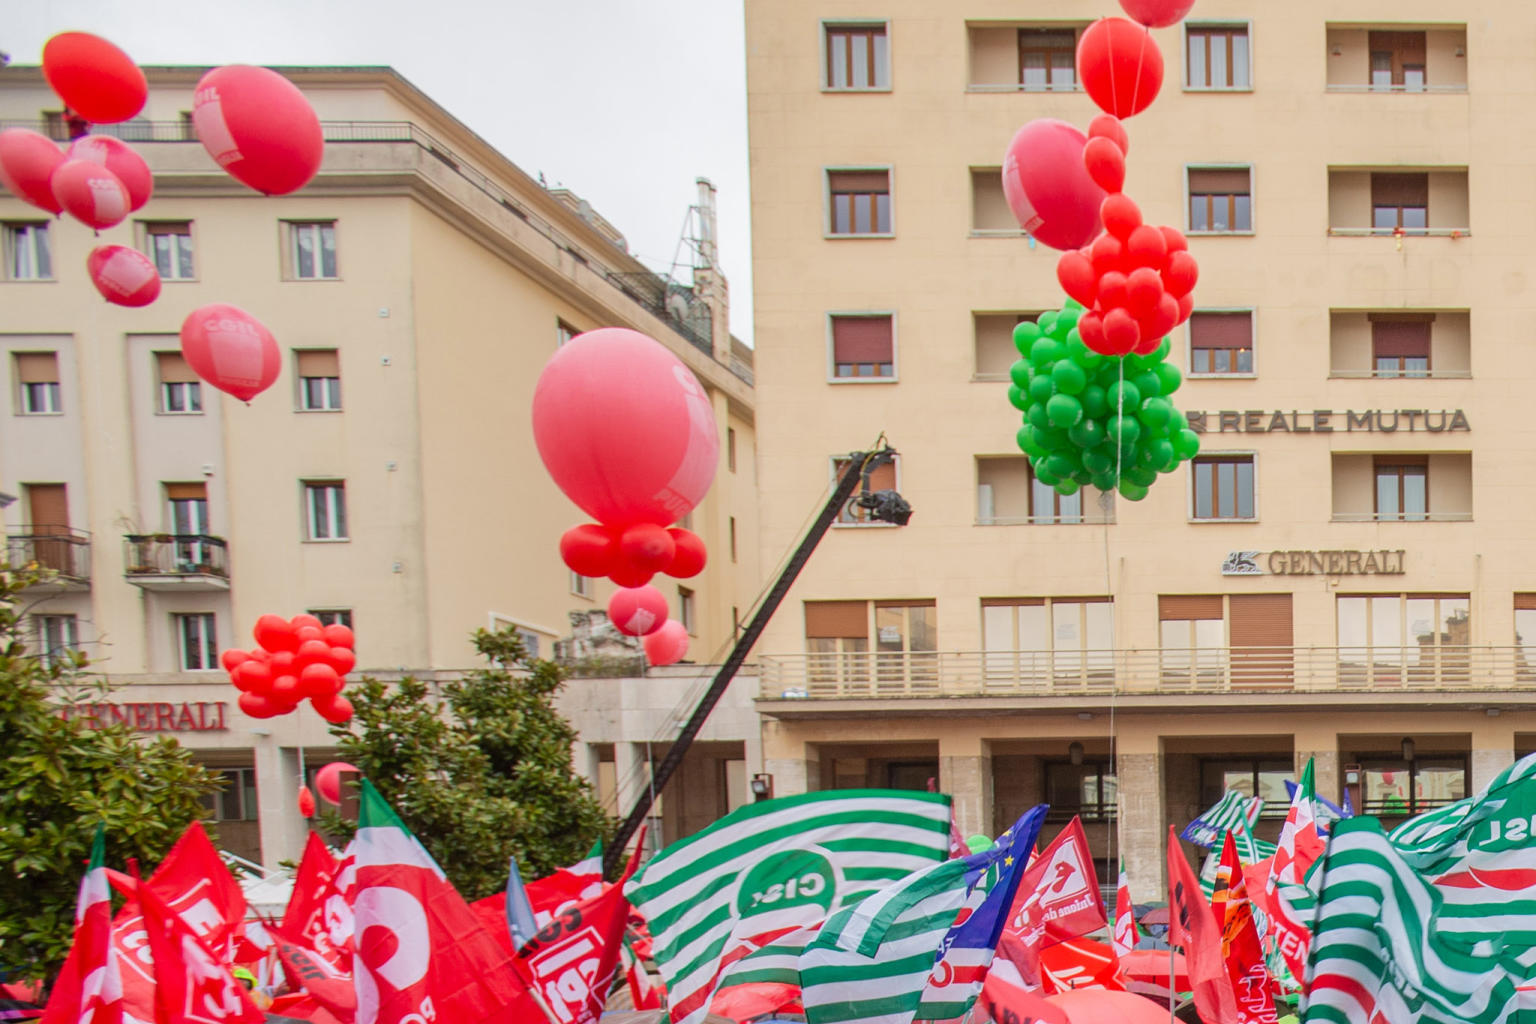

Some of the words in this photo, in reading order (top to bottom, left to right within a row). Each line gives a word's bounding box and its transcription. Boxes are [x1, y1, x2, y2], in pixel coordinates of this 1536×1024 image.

[1219, 410, 1333, 433] REALE
[1347, 409, 1471, 433] MUTUA
[1268, 550, 1406, 575] GENERALI
